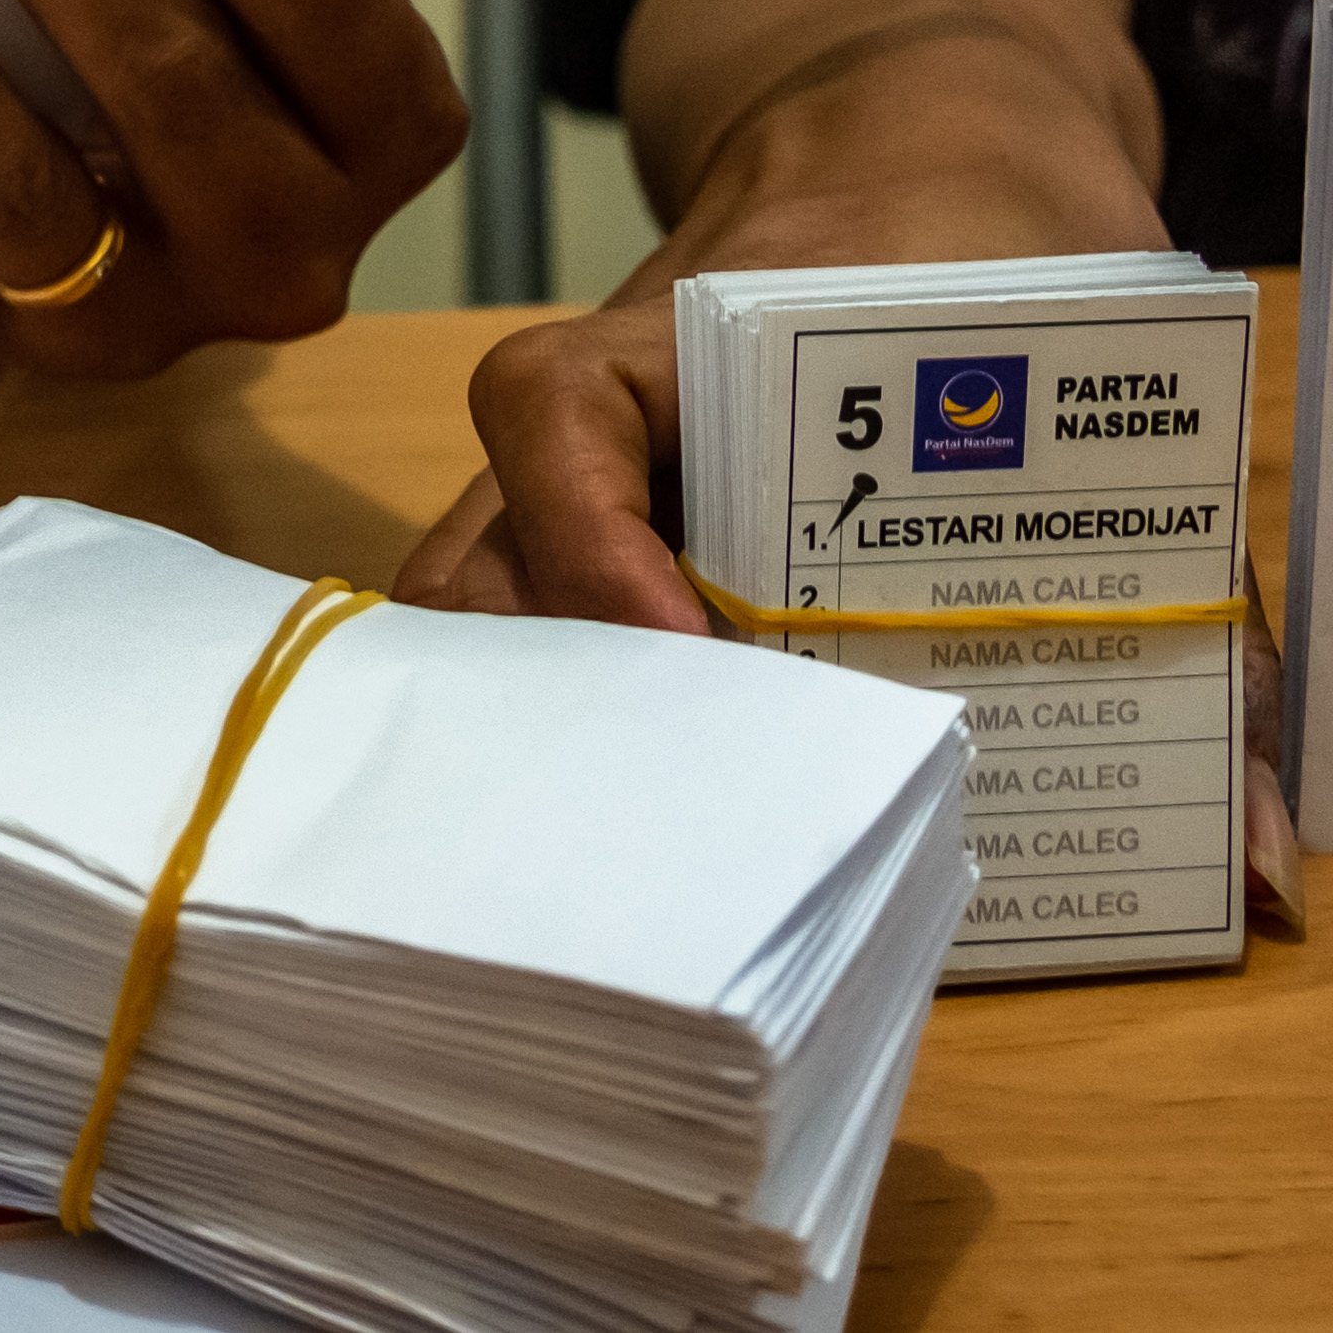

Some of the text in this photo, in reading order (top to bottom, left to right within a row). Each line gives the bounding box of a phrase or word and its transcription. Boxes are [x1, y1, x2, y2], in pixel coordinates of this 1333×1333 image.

[1056, 373, 1179, 404] PARTAI
[835, 385, 883, 451] 5
[1055, 408, 1200, 441] NASDEM
[924, 435, 1015, 453] Partai NasDem
[802, 504, 1220, 551] 1. LESTARI MOERDIJAT
[932, 579, 1025, 608] NAMA
[1033, 573, 1141, 603] CALEG
[931, 634, 1141, 668] NAMA CALEG
[1033, 699, 1140, 729] CALEG
[1033, 763, 1140, 793] CALEG
[1033, 827, 1140, 857] CALEG
[1032, 890, 1139, 920] CALEG
